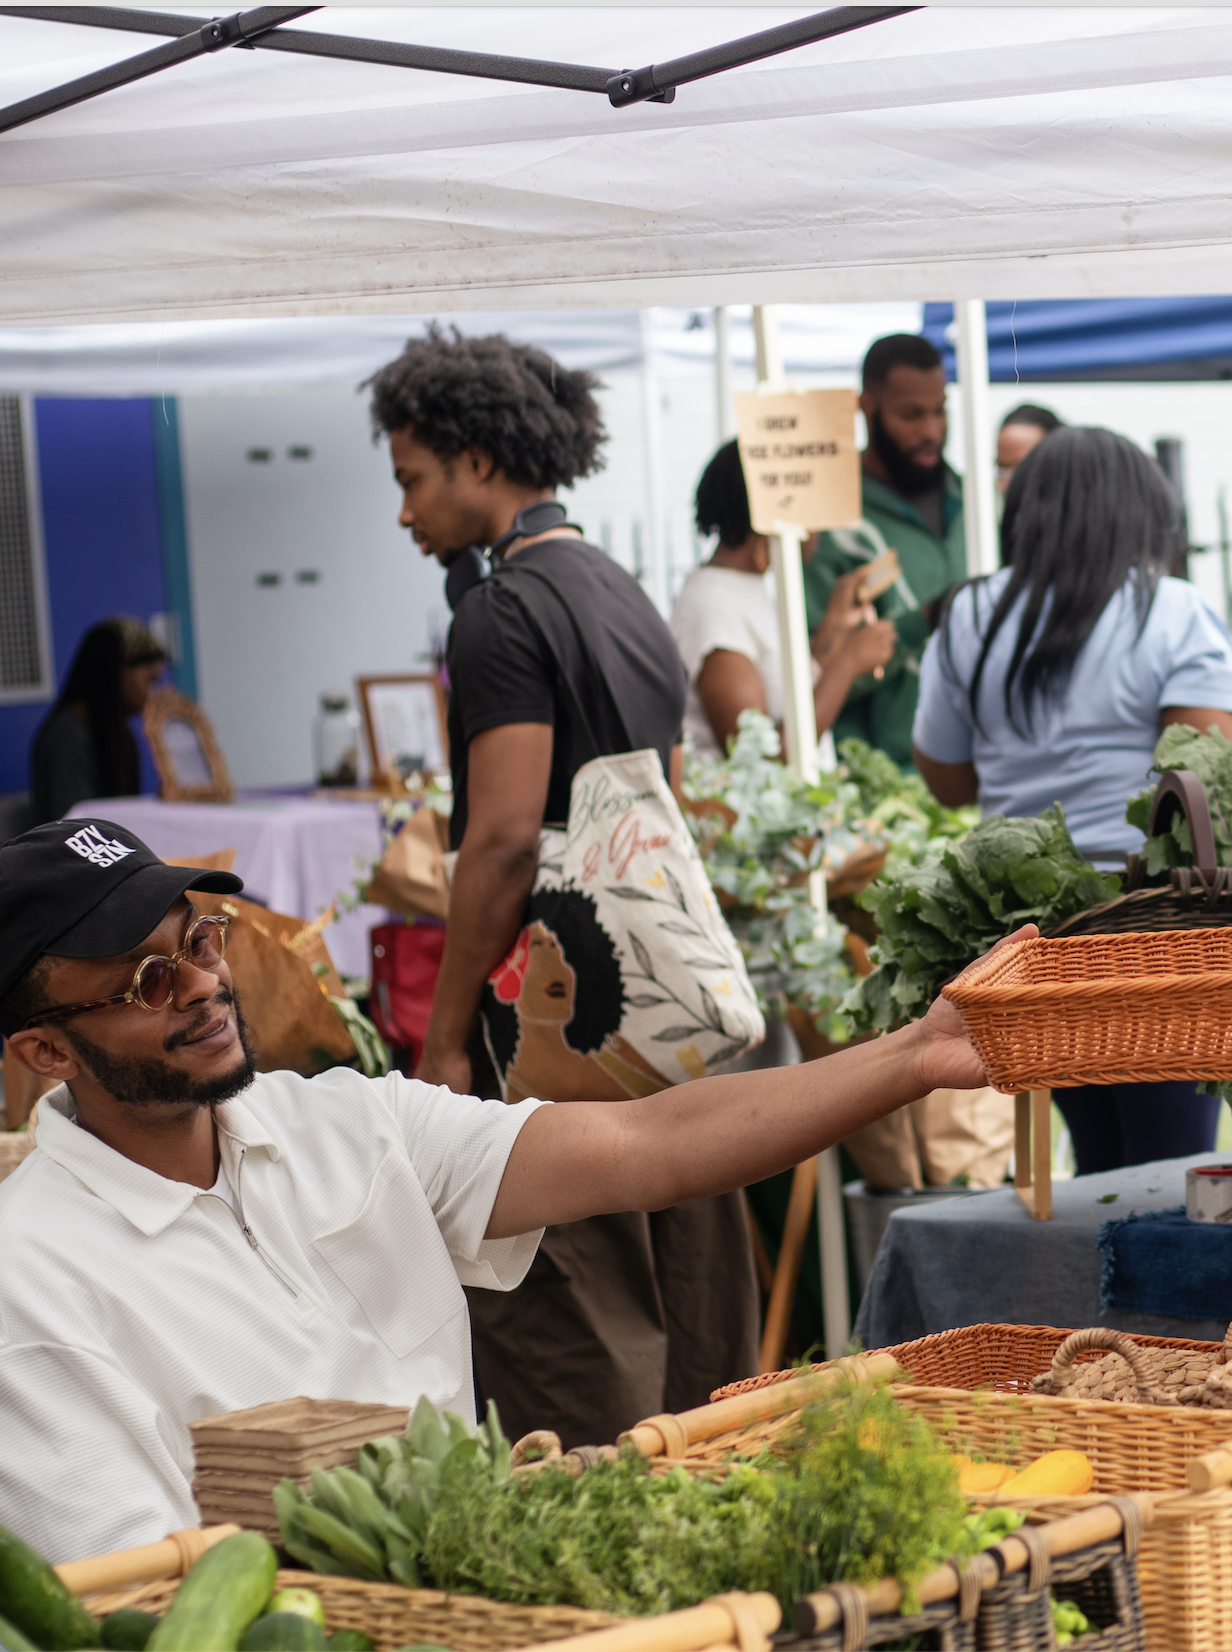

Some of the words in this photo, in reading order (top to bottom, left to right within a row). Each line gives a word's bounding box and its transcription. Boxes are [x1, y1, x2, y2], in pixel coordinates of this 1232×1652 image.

[64, 824, 111, 858] BZY
[87, 839, 137, 868] SZN
[581, 841, 602, 884] &
